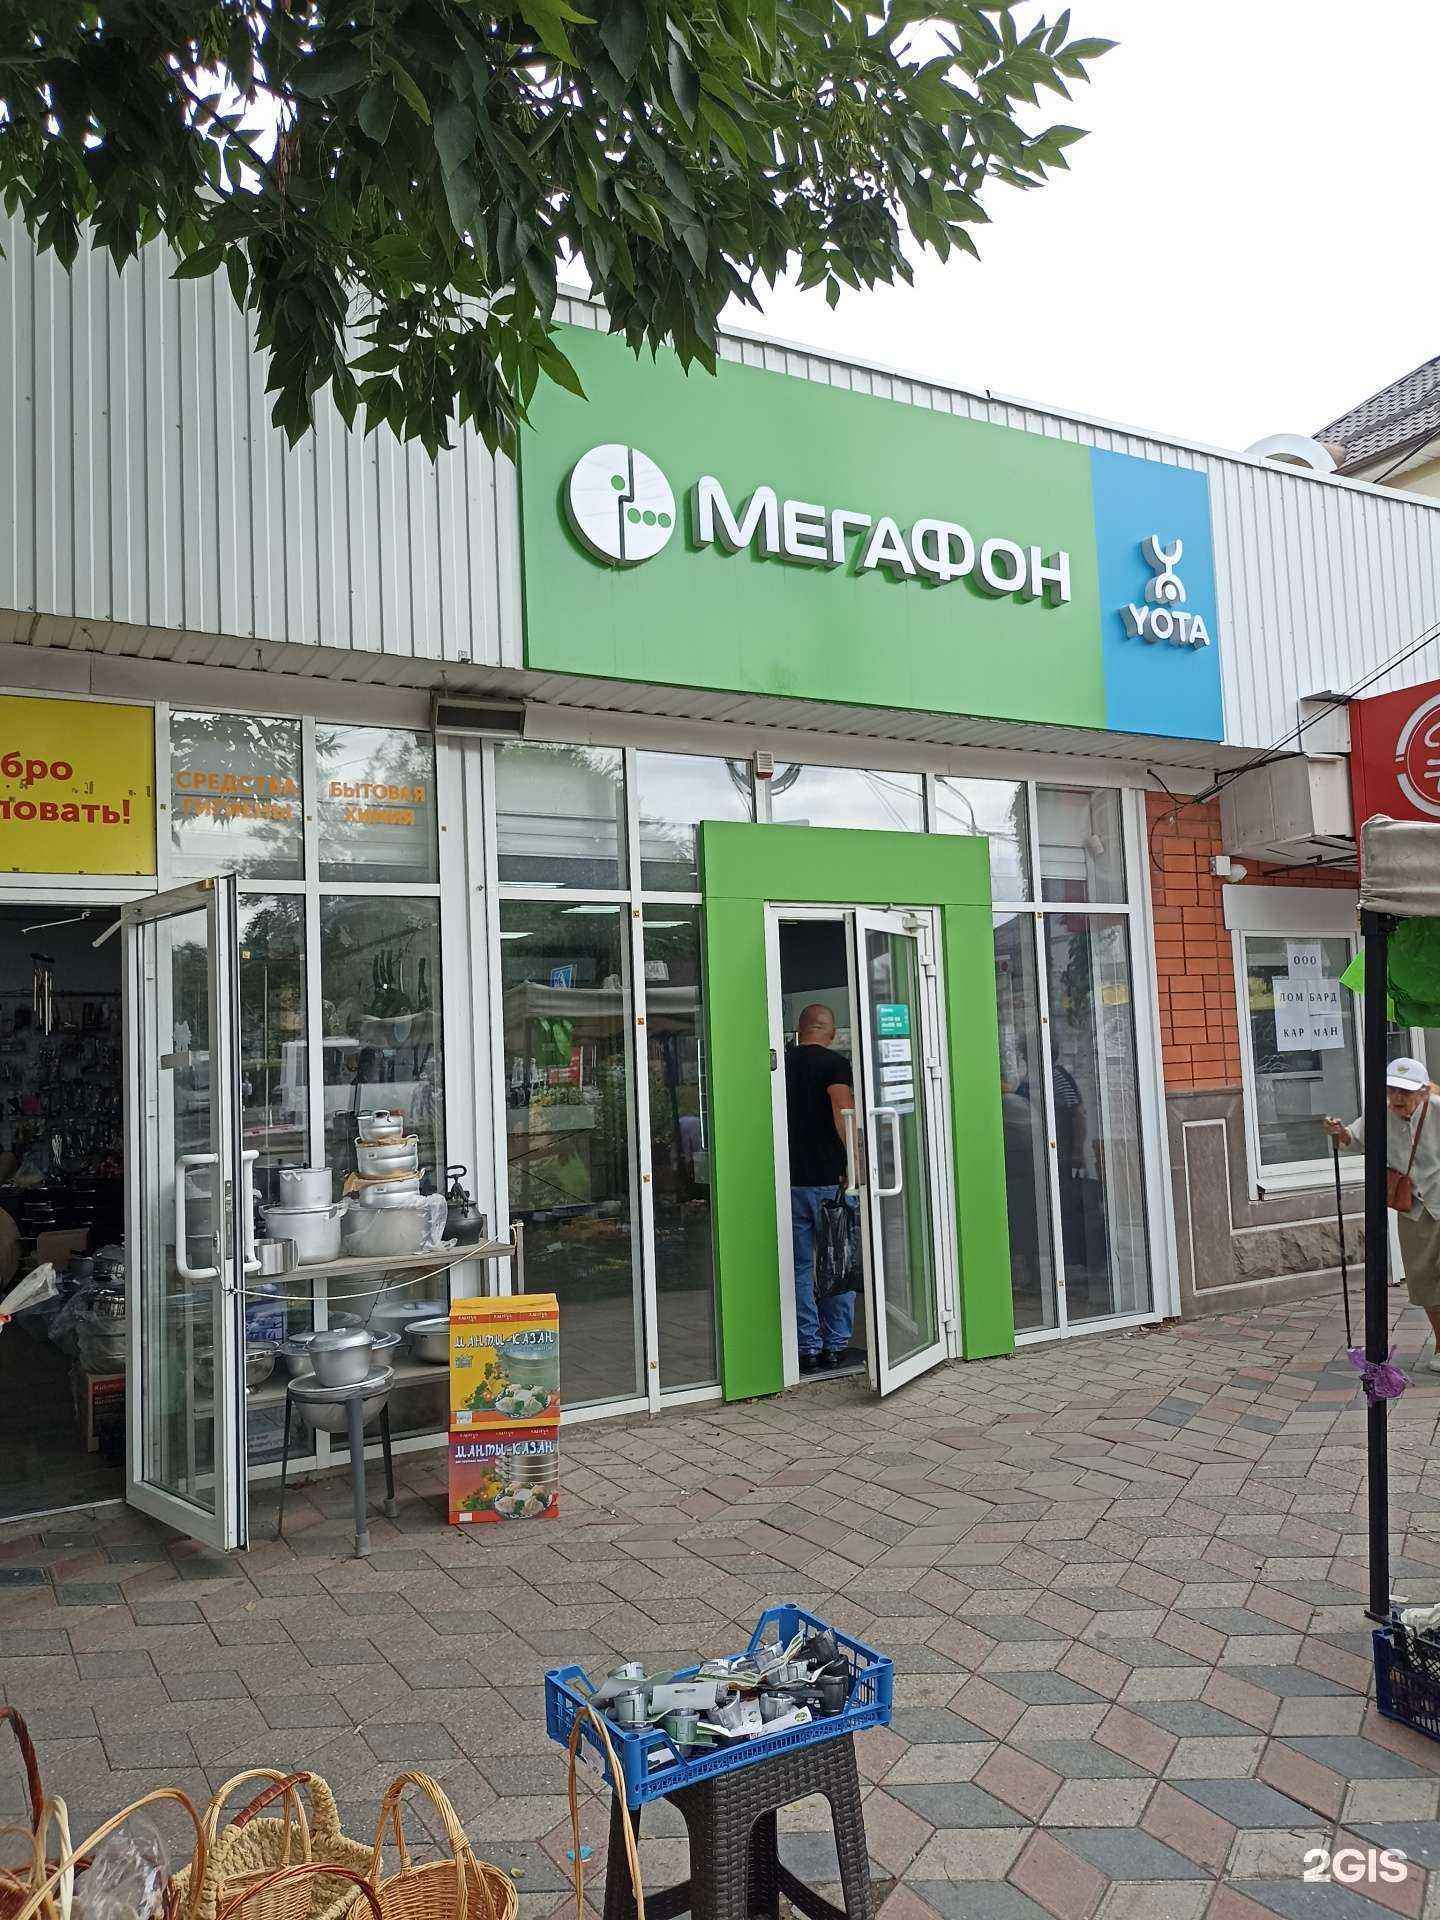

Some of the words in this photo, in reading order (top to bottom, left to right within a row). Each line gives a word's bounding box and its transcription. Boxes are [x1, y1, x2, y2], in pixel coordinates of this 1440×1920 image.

[695, 474, 1072, 605] МЕГАФОН
[1127, 602, 1211, 650] YOTA
[329, 780, 426, 803] БЫТОВАЯ
[1293, 955, 1317, 966] ООО
